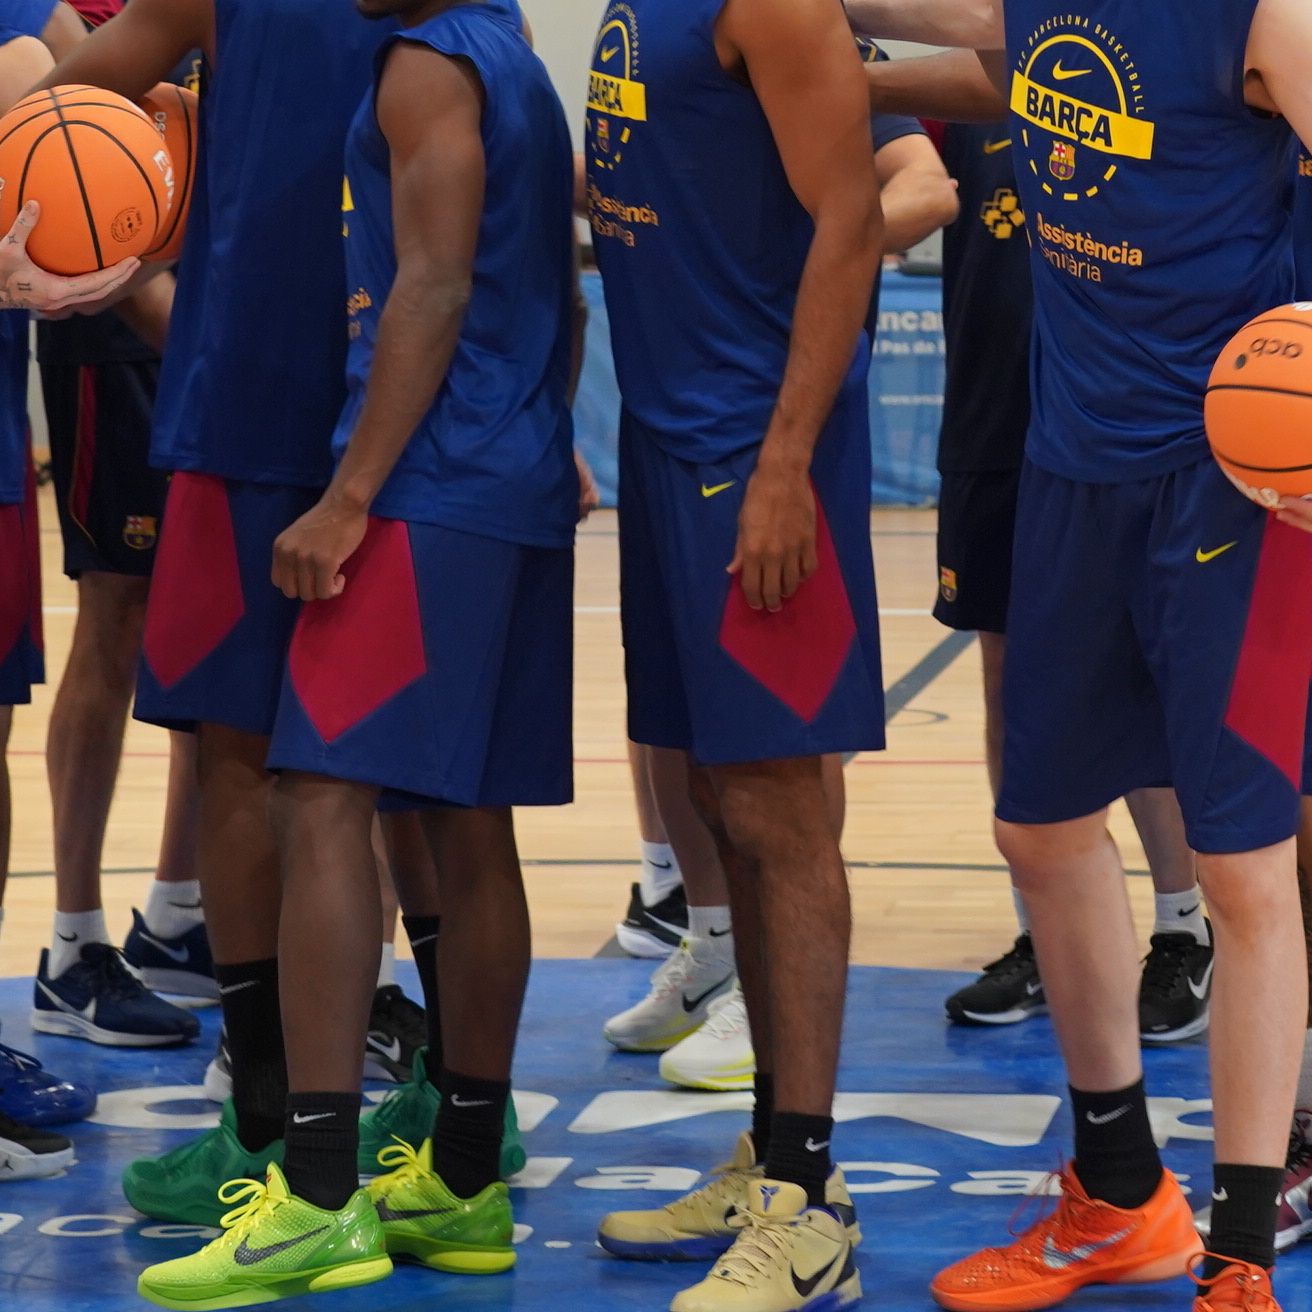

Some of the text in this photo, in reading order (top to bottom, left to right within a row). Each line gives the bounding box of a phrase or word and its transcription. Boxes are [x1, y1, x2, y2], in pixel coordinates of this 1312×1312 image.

[1028, 14, 1089, 47] BARCELONA
[1094, 23, 1146, 114] BASKETBALL
[1025, 84, 1113, 148] BARÇA
[1036, 211, 1144, 267] Assistència
[1249, 338, 1303, 359] acb
